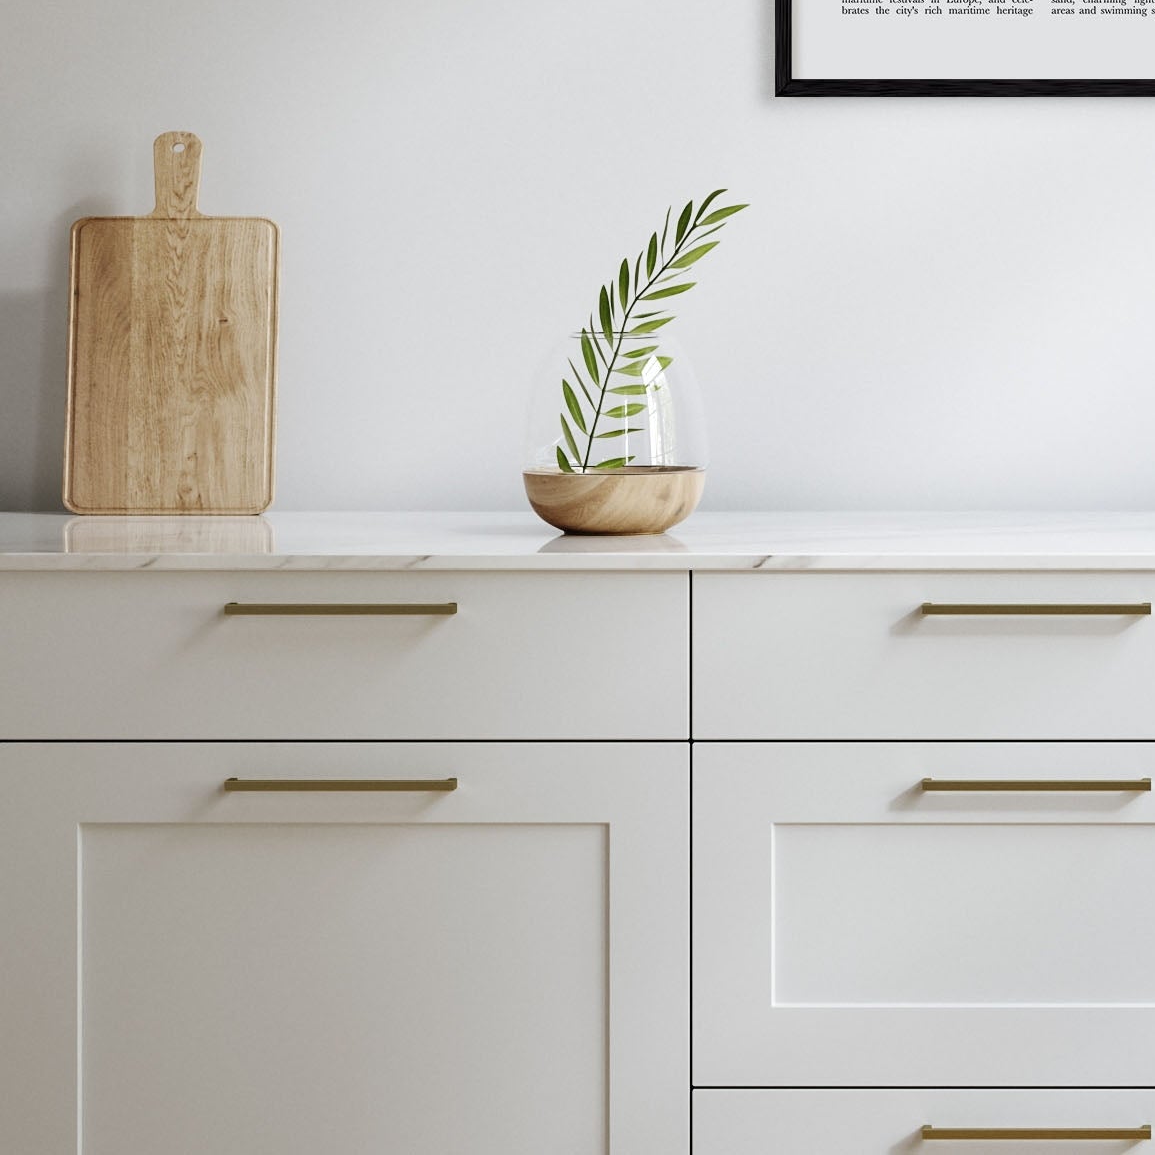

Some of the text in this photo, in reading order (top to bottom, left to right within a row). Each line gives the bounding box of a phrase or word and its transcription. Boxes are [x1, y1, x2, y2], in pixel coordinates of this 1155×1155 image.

[841, 6, 1034, 17] brates the city's rich maritime heritage
[1078, 6, 1097, 15] and
[1100, 6, 1148, 17] swimming
